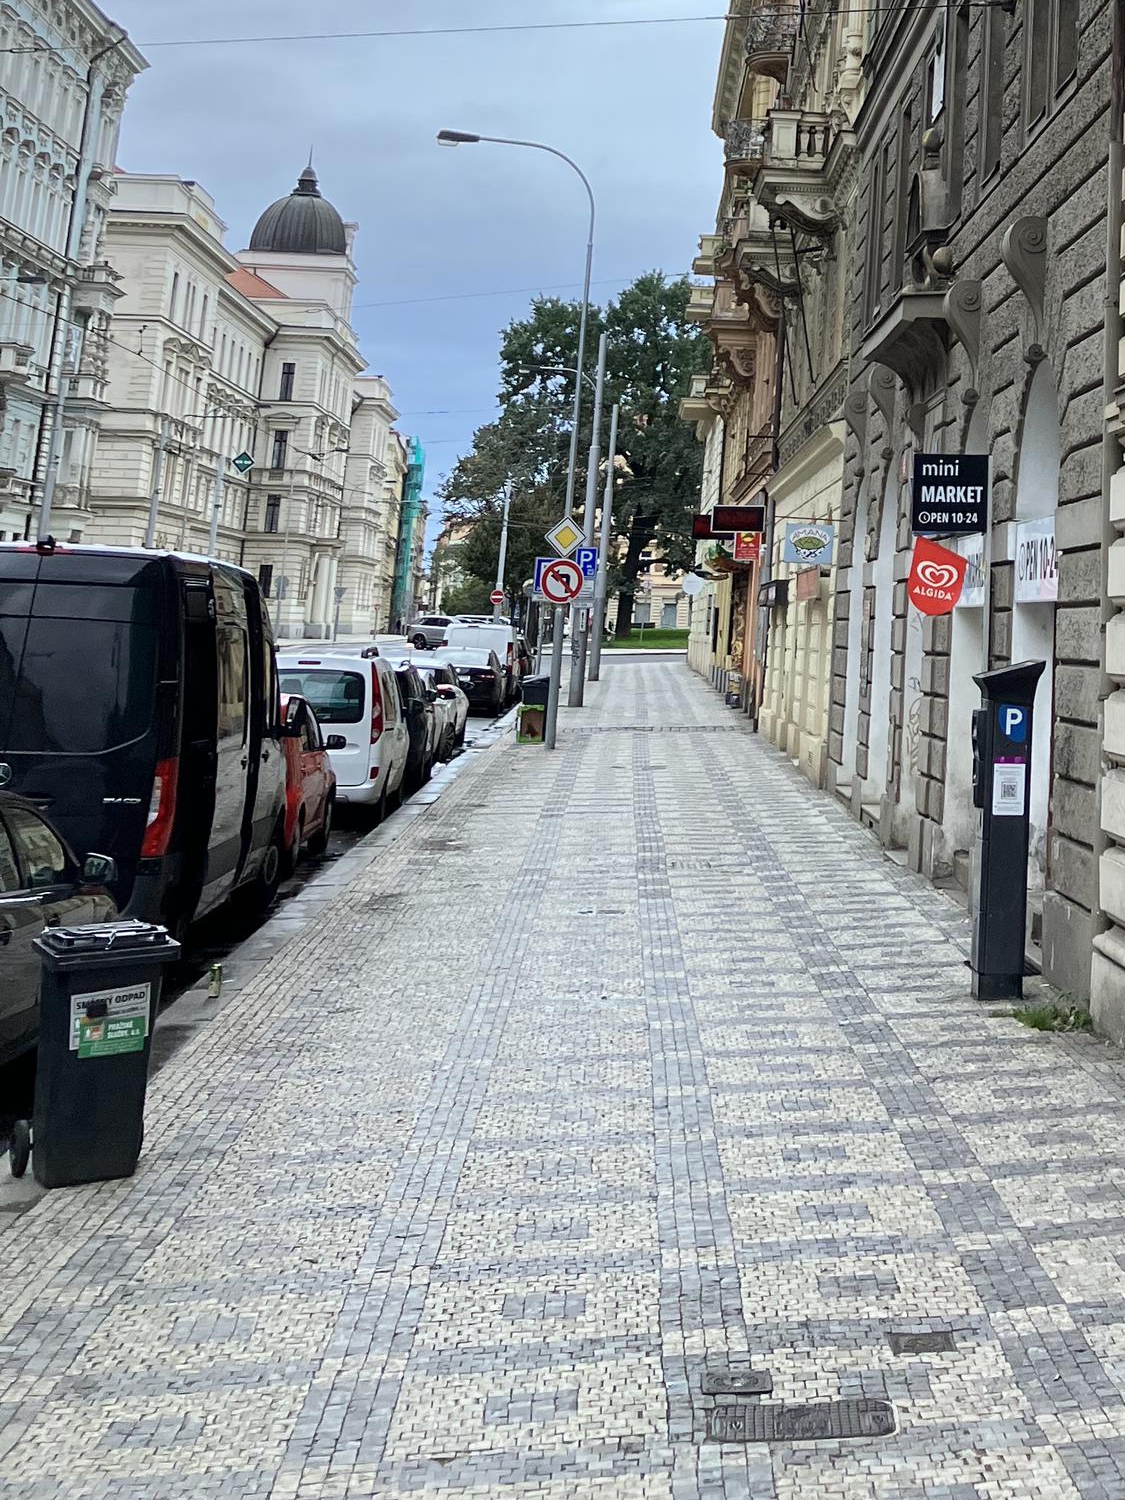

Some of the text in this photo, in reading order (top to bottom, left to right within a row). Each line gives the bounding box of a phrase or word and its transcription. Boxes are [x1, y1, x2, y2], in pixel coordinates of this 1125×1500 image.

[922, 459, 960, 476] mini
[921, 485, 984, 503] MARKET
[951, 512, 979, 524] 10-24
[580, 550, 594, 569] P
[912, 585, 953, 601] ALGIDA
[1005, 708, 1023, 735] P
[115, 991, 146, 1004] ODPAD
